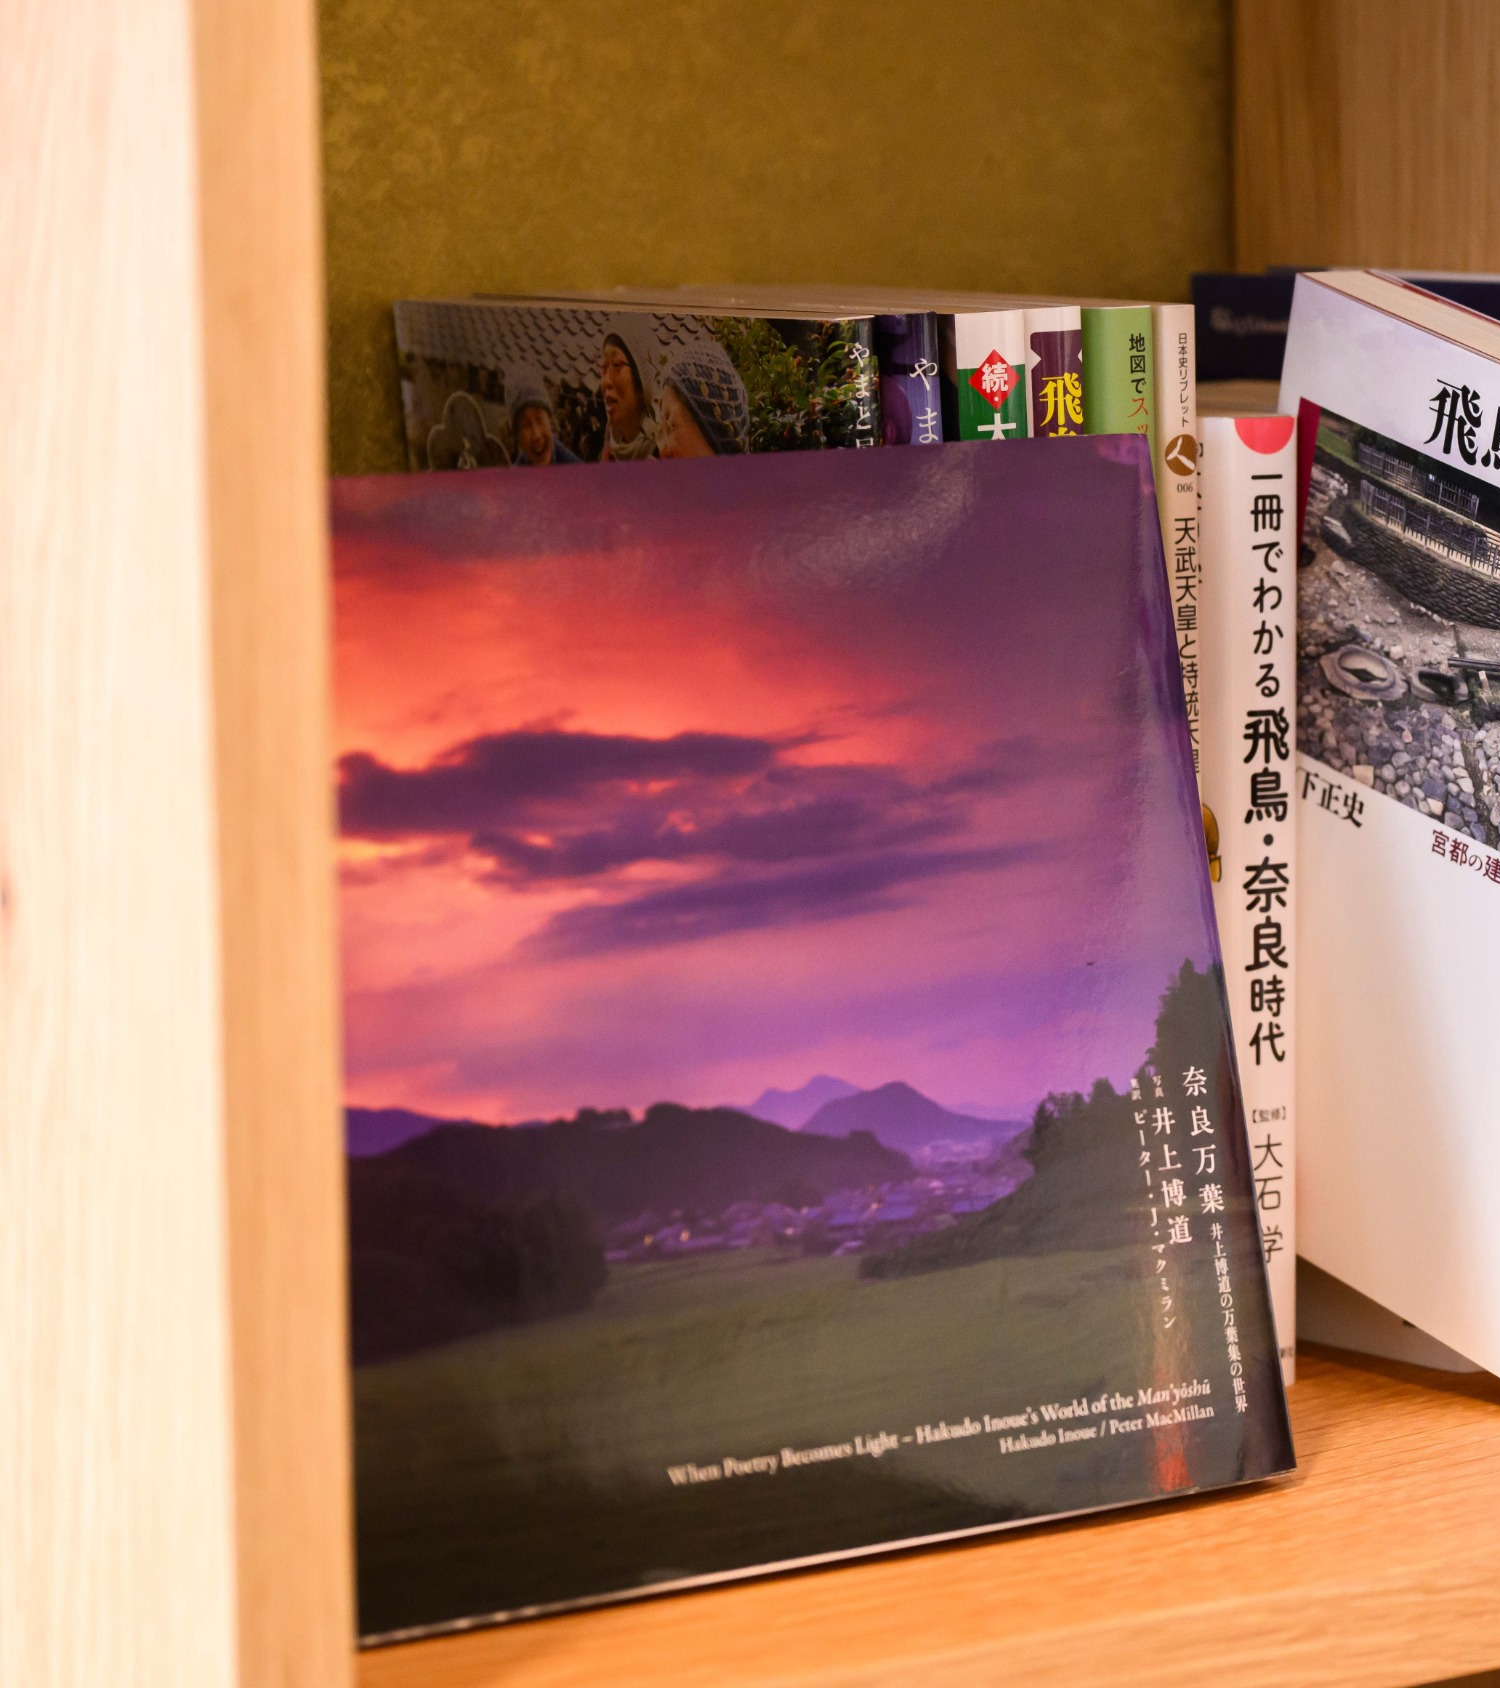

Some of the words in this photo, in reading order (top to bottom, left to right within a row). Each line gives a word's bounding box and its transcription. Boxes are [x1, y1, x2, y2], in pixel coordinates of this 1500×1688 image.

[1038, 372, 1084, 438] 飛
[1178, 332, 1190, 428] 日本史リブレット
[1176, 482, 1193, 494] 006
[1151, 1106, 1193, 1245] 井上博道
[1181, 1065, 1226, 1214] 奈良万葉
[1210, 1222, 1248, 1413] 井上博道の万葉集の世界
[667, 1463, 722, 1486] When
[722, 1454, 778, 1476] Poetry
[780, 1447, 853, 1468] Becomes
[854, 1430, 898, 1458] Light
[915, 1416, 982, 1445] Hakudo
[1039, 1397, 1089, 1422] World
[1091, 1393, 1109, 1415] of
[1109, 1391, 1134, 1411] the
[1000, 1430, 1057, 1455] Hakudo
[1057, 1425, 1097, 1445] Inoue
[1108, 1417, 1144, 1436] Peter
[1145, 1403, 1215, 1429] MacMillan
